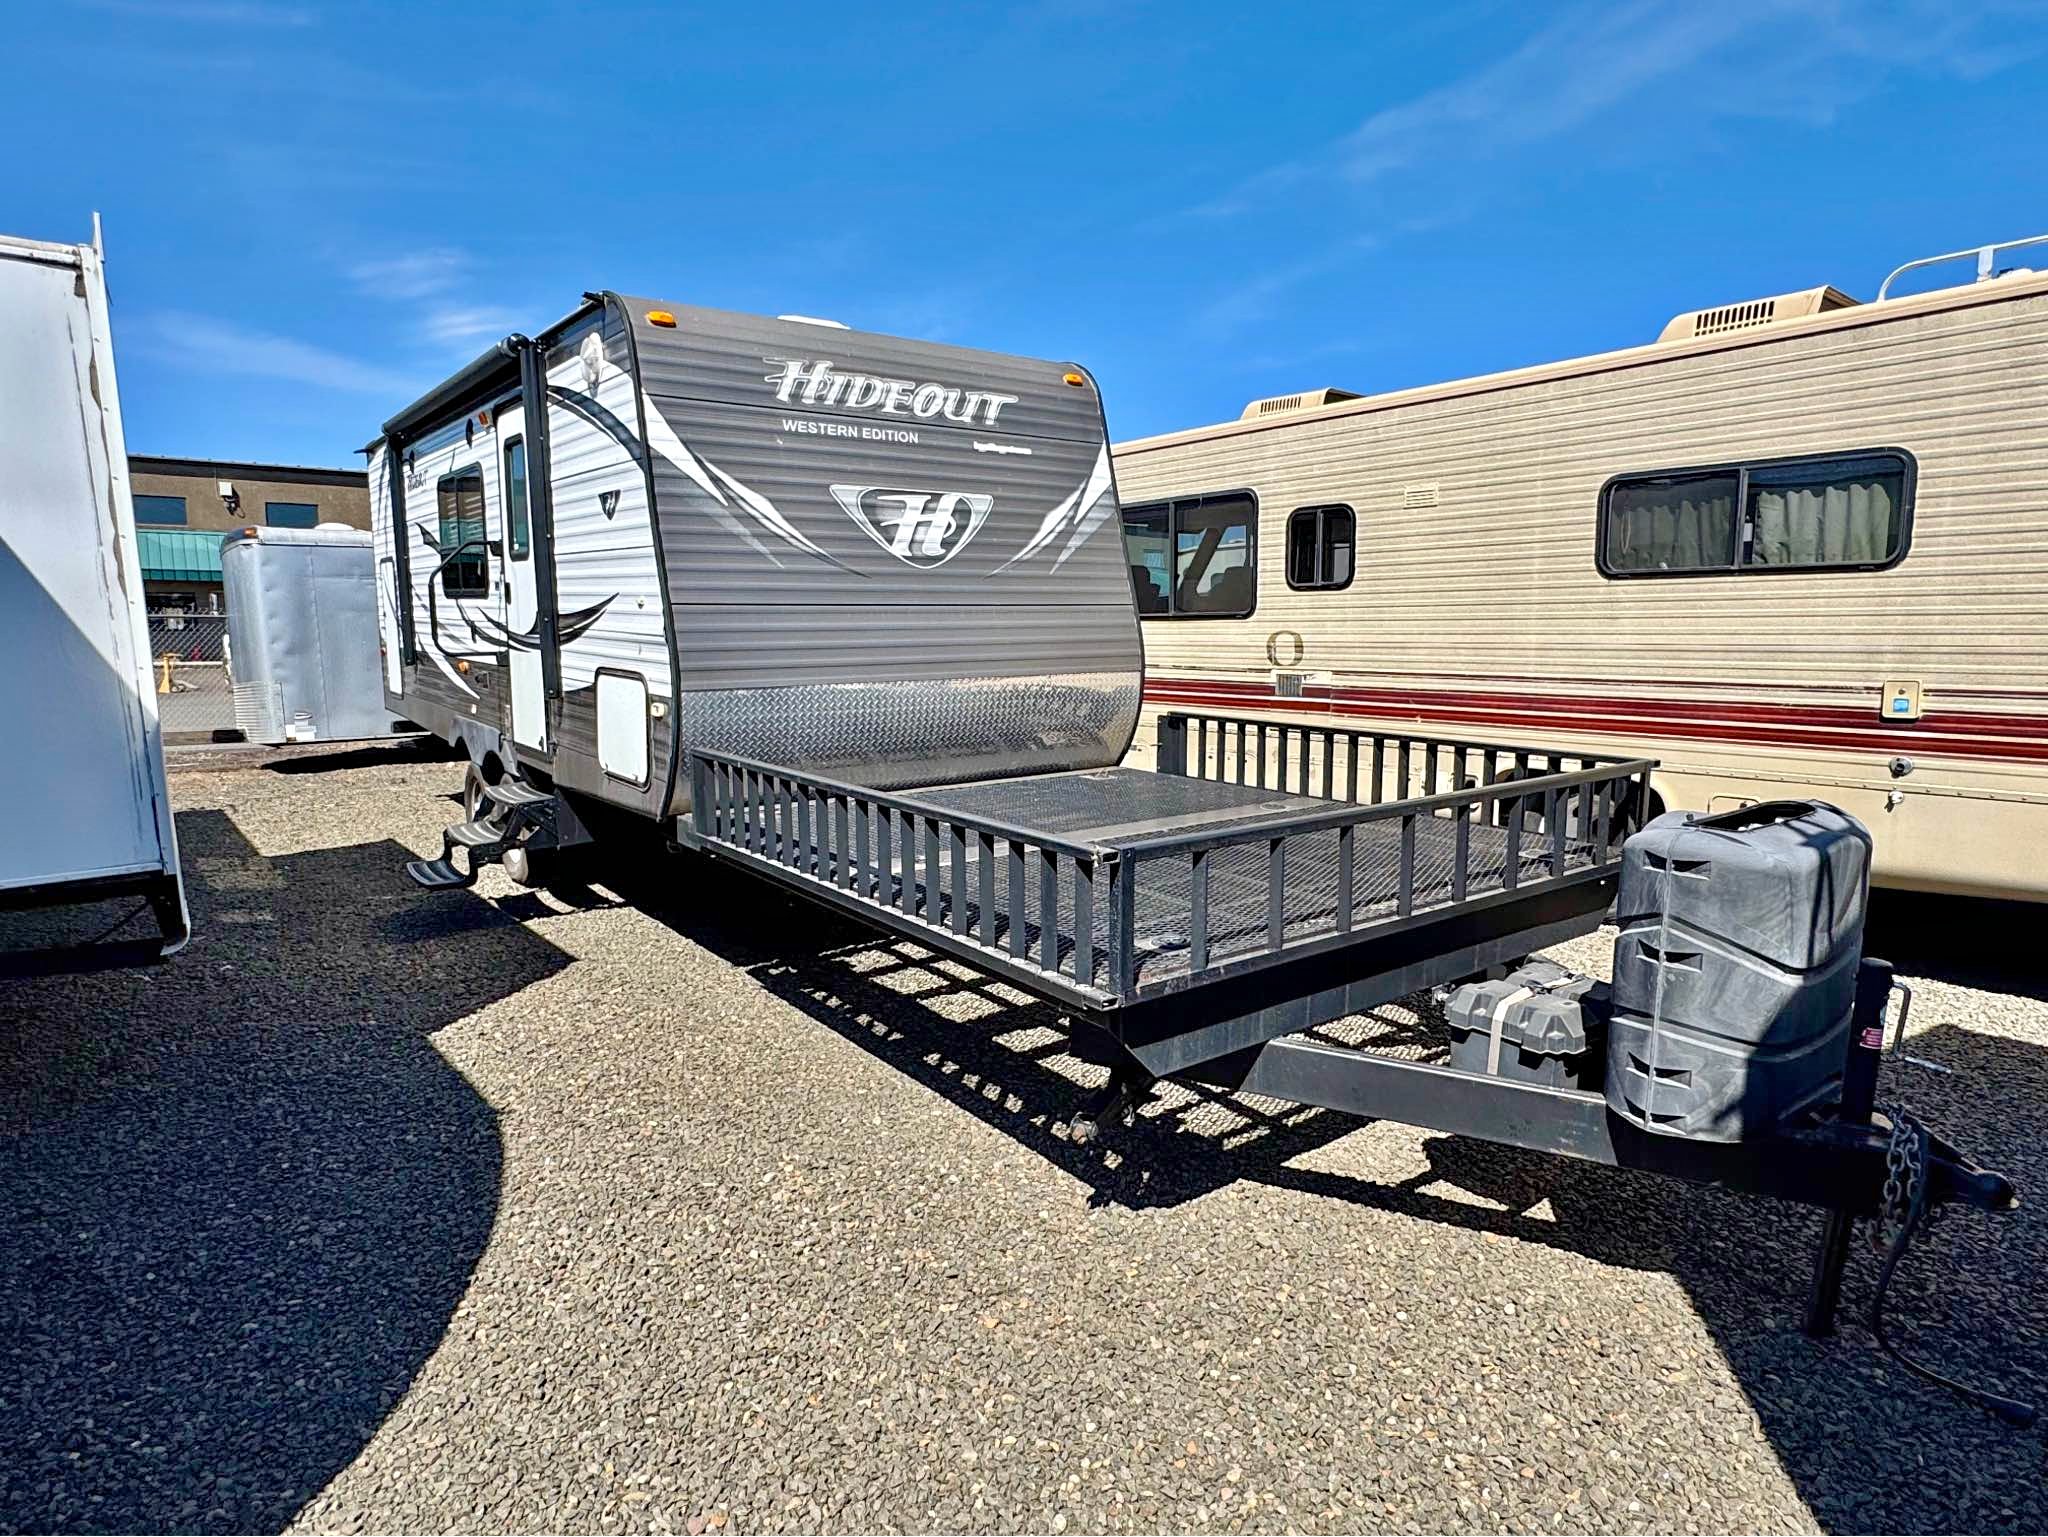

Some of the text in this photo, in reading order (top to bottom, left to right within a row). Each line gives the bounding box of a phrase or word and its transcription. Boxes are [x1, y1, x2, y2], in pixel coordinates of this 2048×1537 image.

[763, 357, 1019, 425] HIDEOUT
[782, 419, 919, 444] WESTERN EDITION
